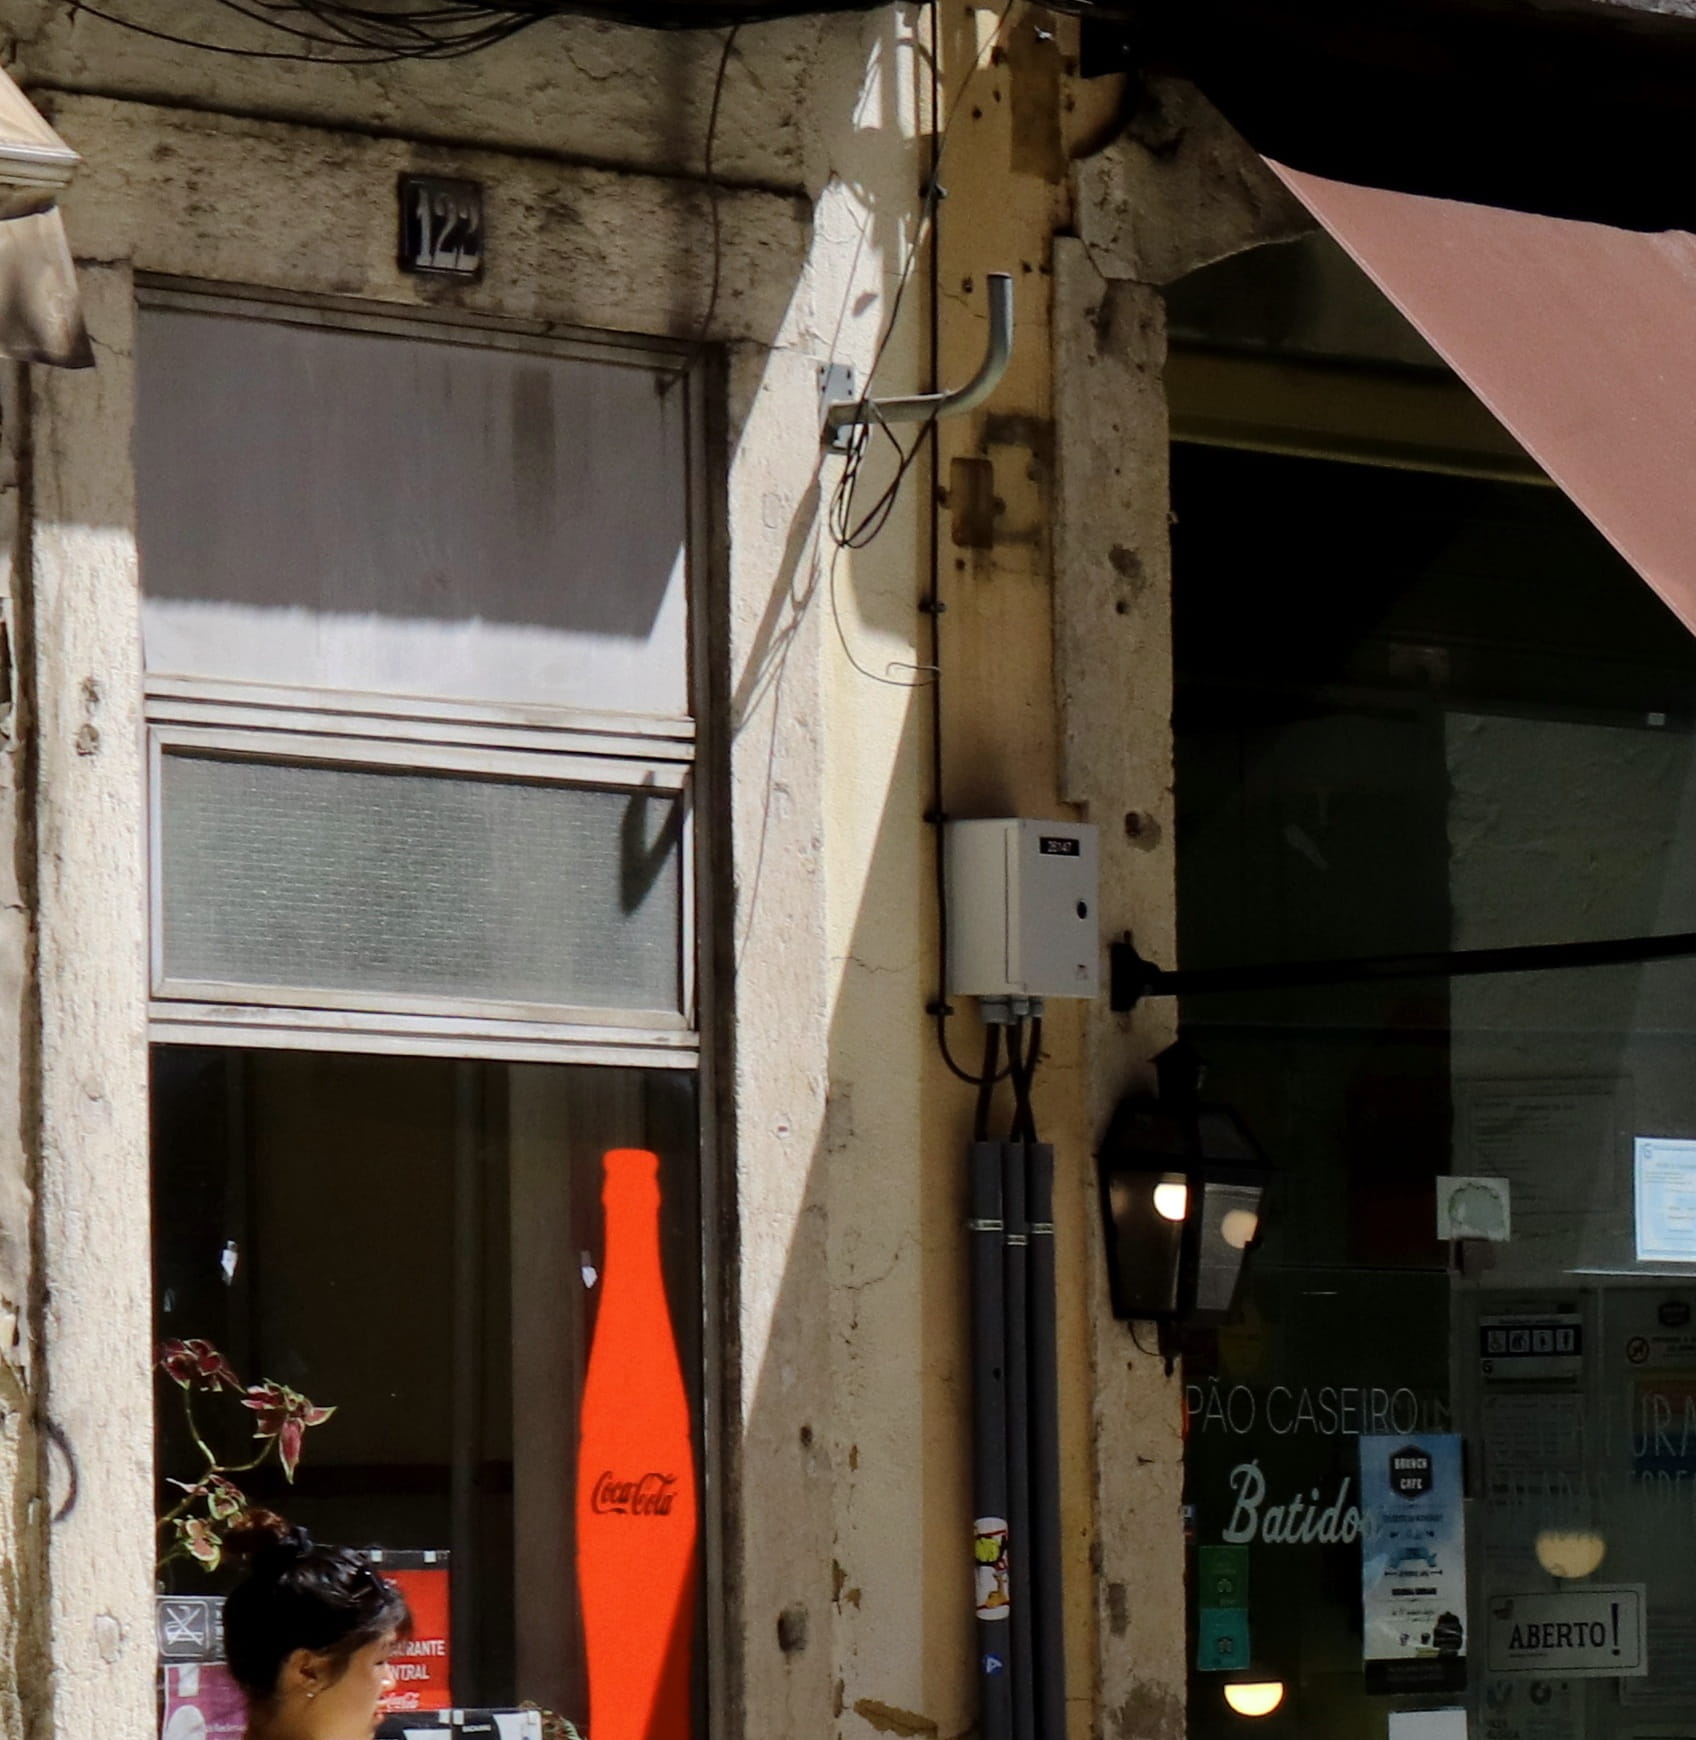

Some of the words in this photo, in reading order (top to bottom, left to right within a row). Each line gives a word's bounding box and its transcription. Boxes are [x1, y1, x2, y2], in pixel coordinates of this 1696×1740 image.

[1185, 1375, 1257, 1435] PÃO
[1265, 1383, 1420, 1436] CASEIRO
[390, 1664, 431, 1682] NTRAL
